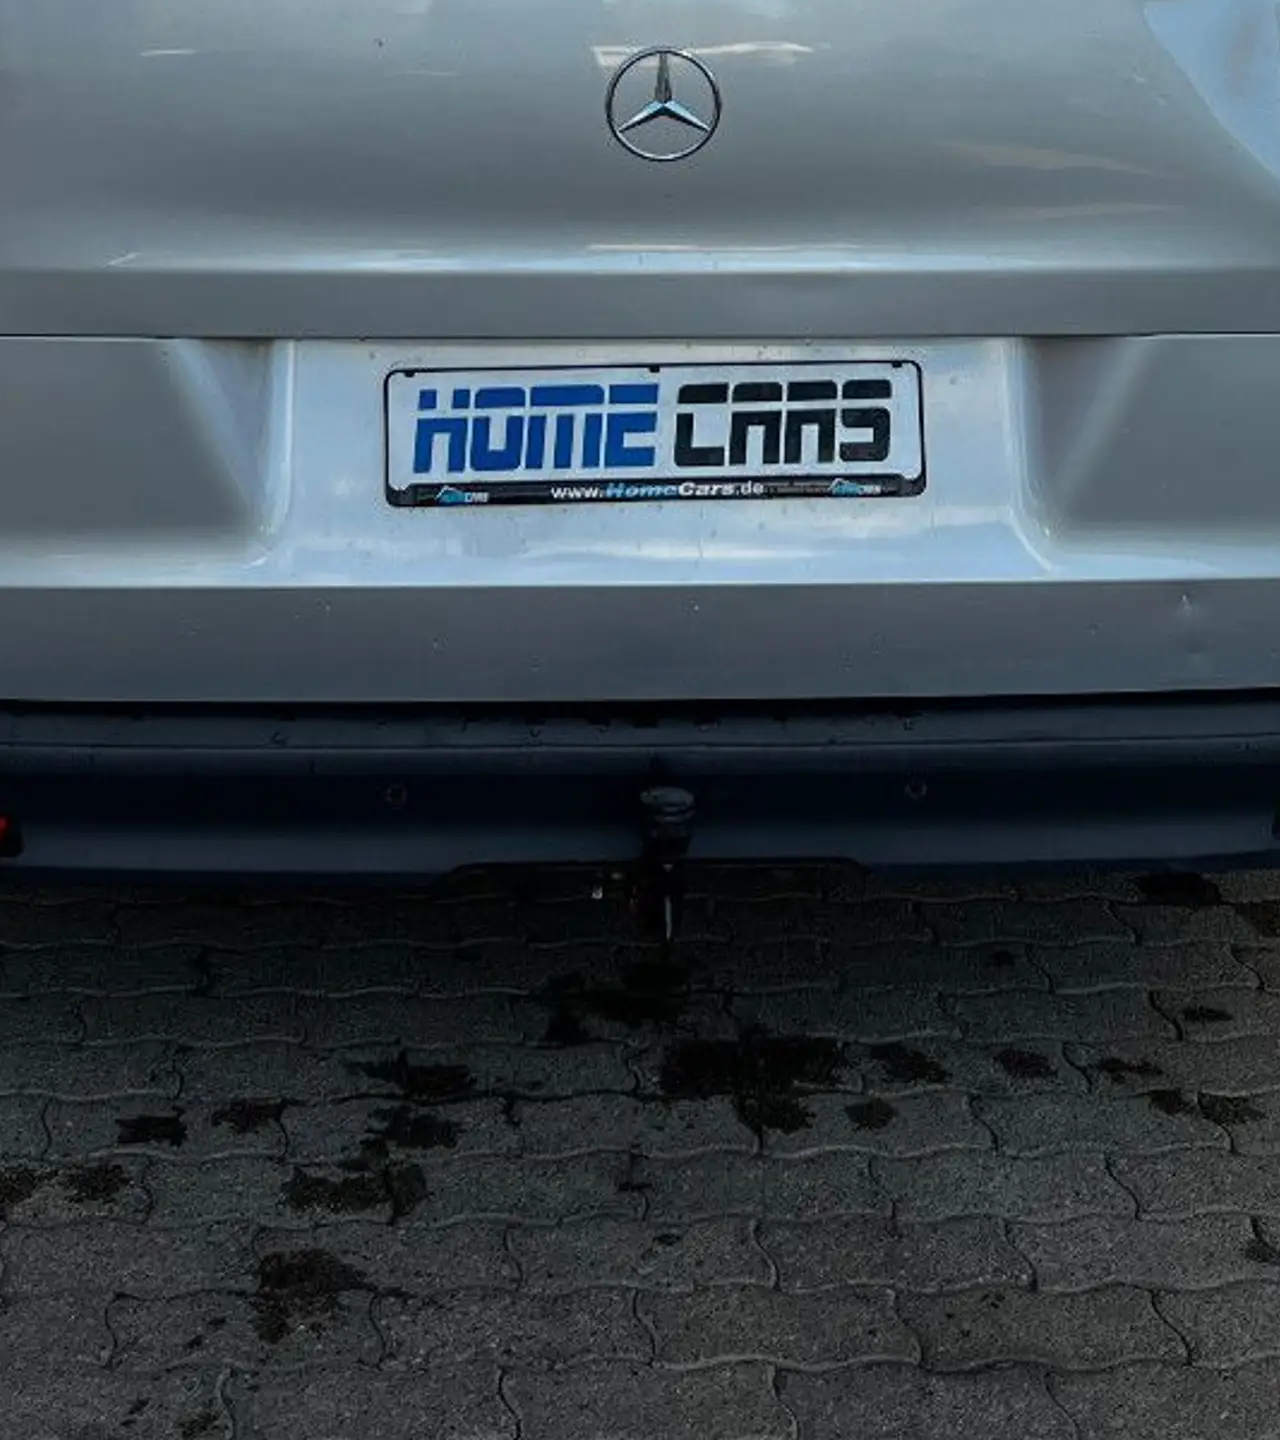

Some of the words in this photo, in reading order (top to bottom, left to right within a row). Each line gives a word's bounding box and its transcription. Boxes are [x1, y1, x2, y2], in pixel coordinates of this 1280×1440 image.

[412, 383, 660, 474] HOME
[672, 378, 893, 468] CARS
[550, 479, 765, 500] www.HomeCars.de
